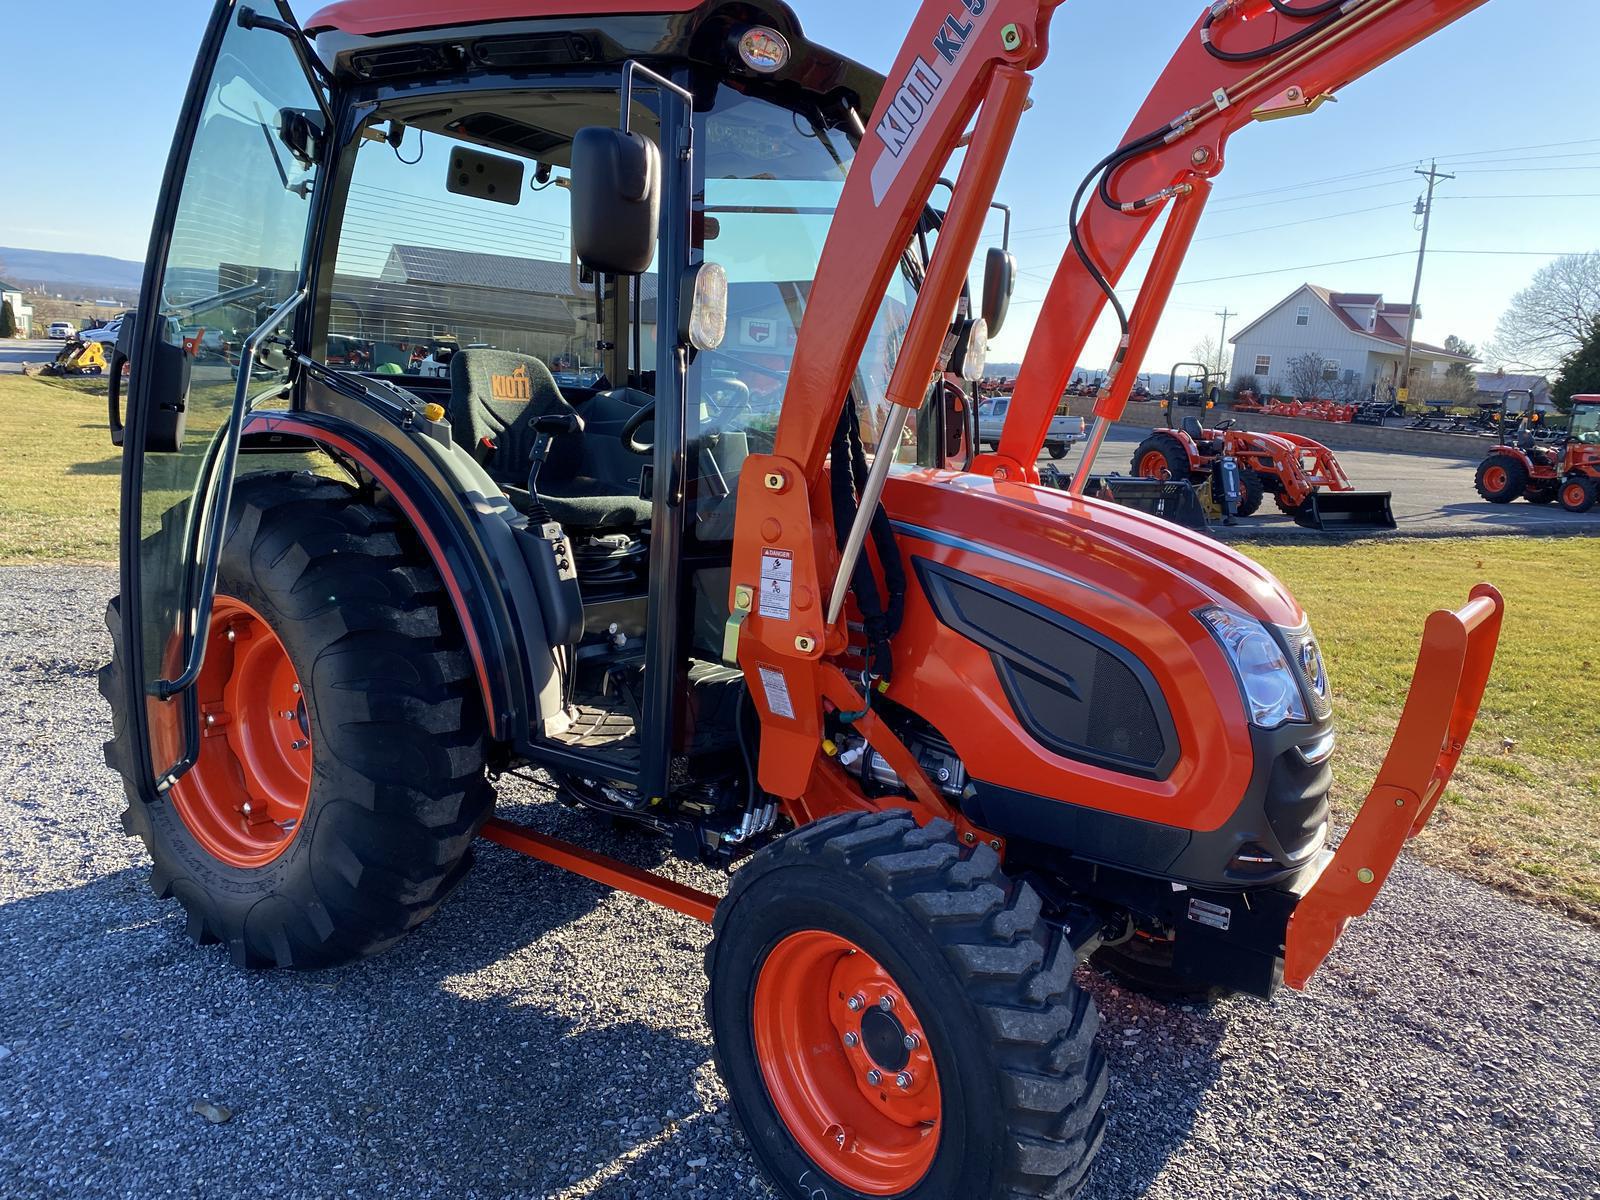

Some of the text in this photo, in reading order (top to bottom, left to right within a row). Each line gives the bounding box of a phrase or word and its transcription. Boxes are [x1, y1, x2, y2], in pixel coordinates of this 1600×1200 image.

[875, 54, 943, 158] KIOTI
[932, 13, 975, 65] KL
[491, 374, 530, 400] KIOTI
